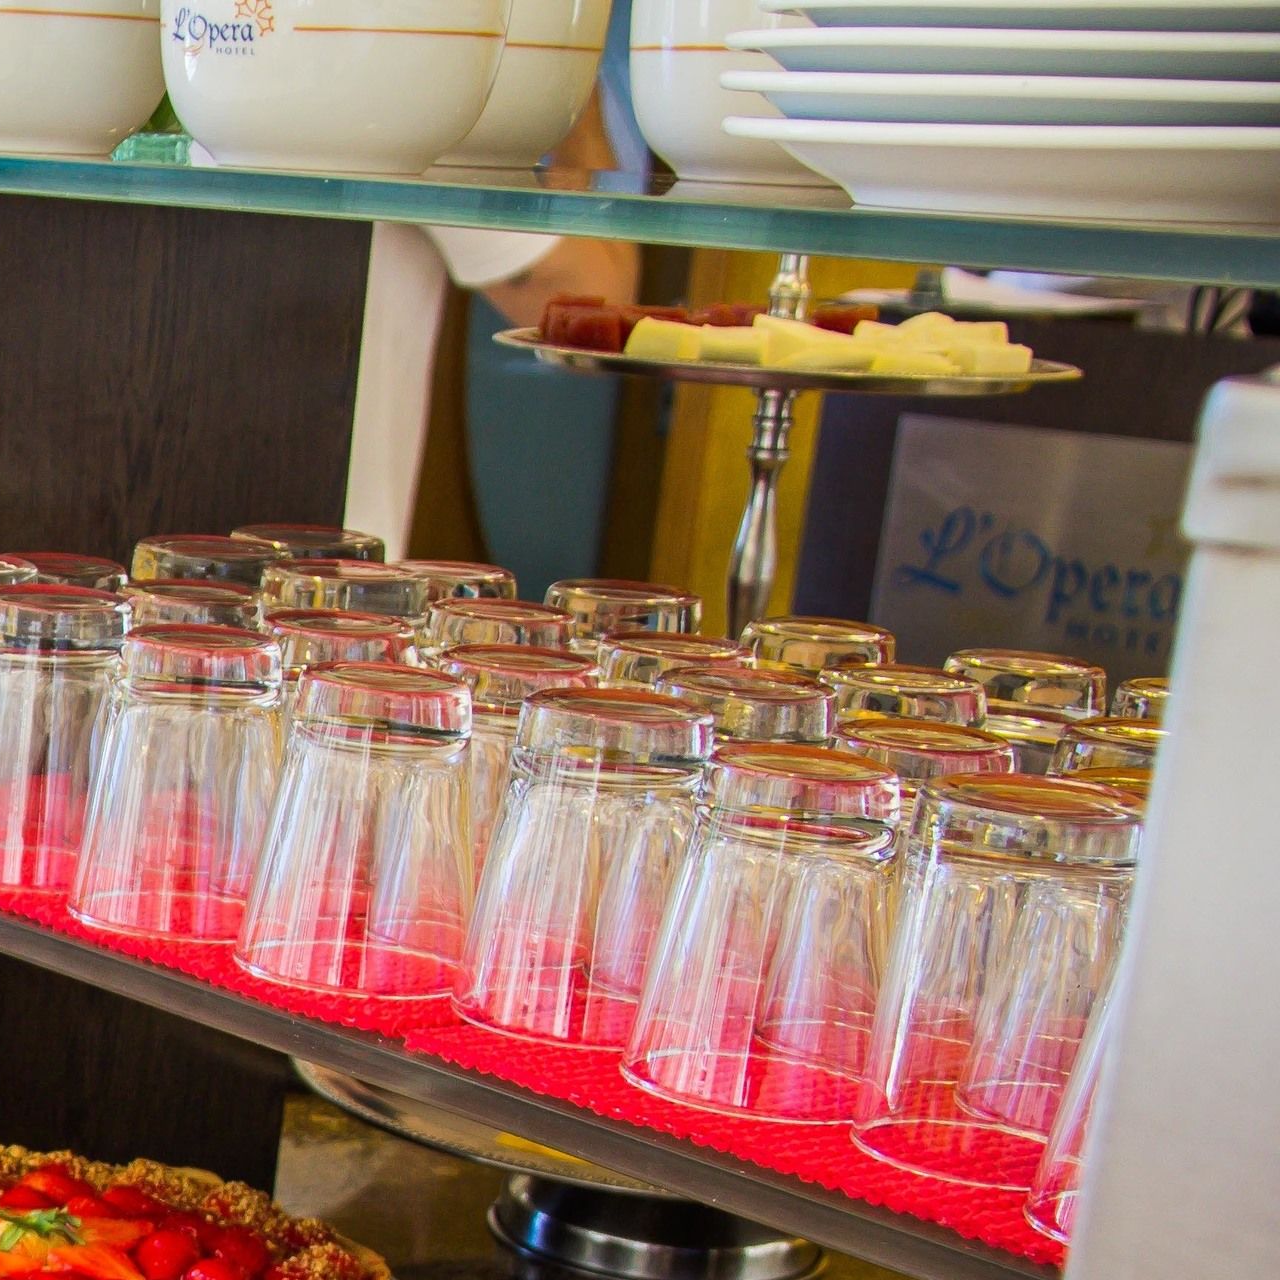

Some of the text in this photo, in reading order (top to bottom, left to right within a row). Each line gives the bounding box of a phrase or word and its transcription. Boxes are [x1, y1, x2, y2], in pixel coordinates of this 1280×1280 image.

[172, 7, 254, 48] L'Opera
[215, 46, 255, 56] HOTEL
[895, 504, 1183, 624] L'Opera
